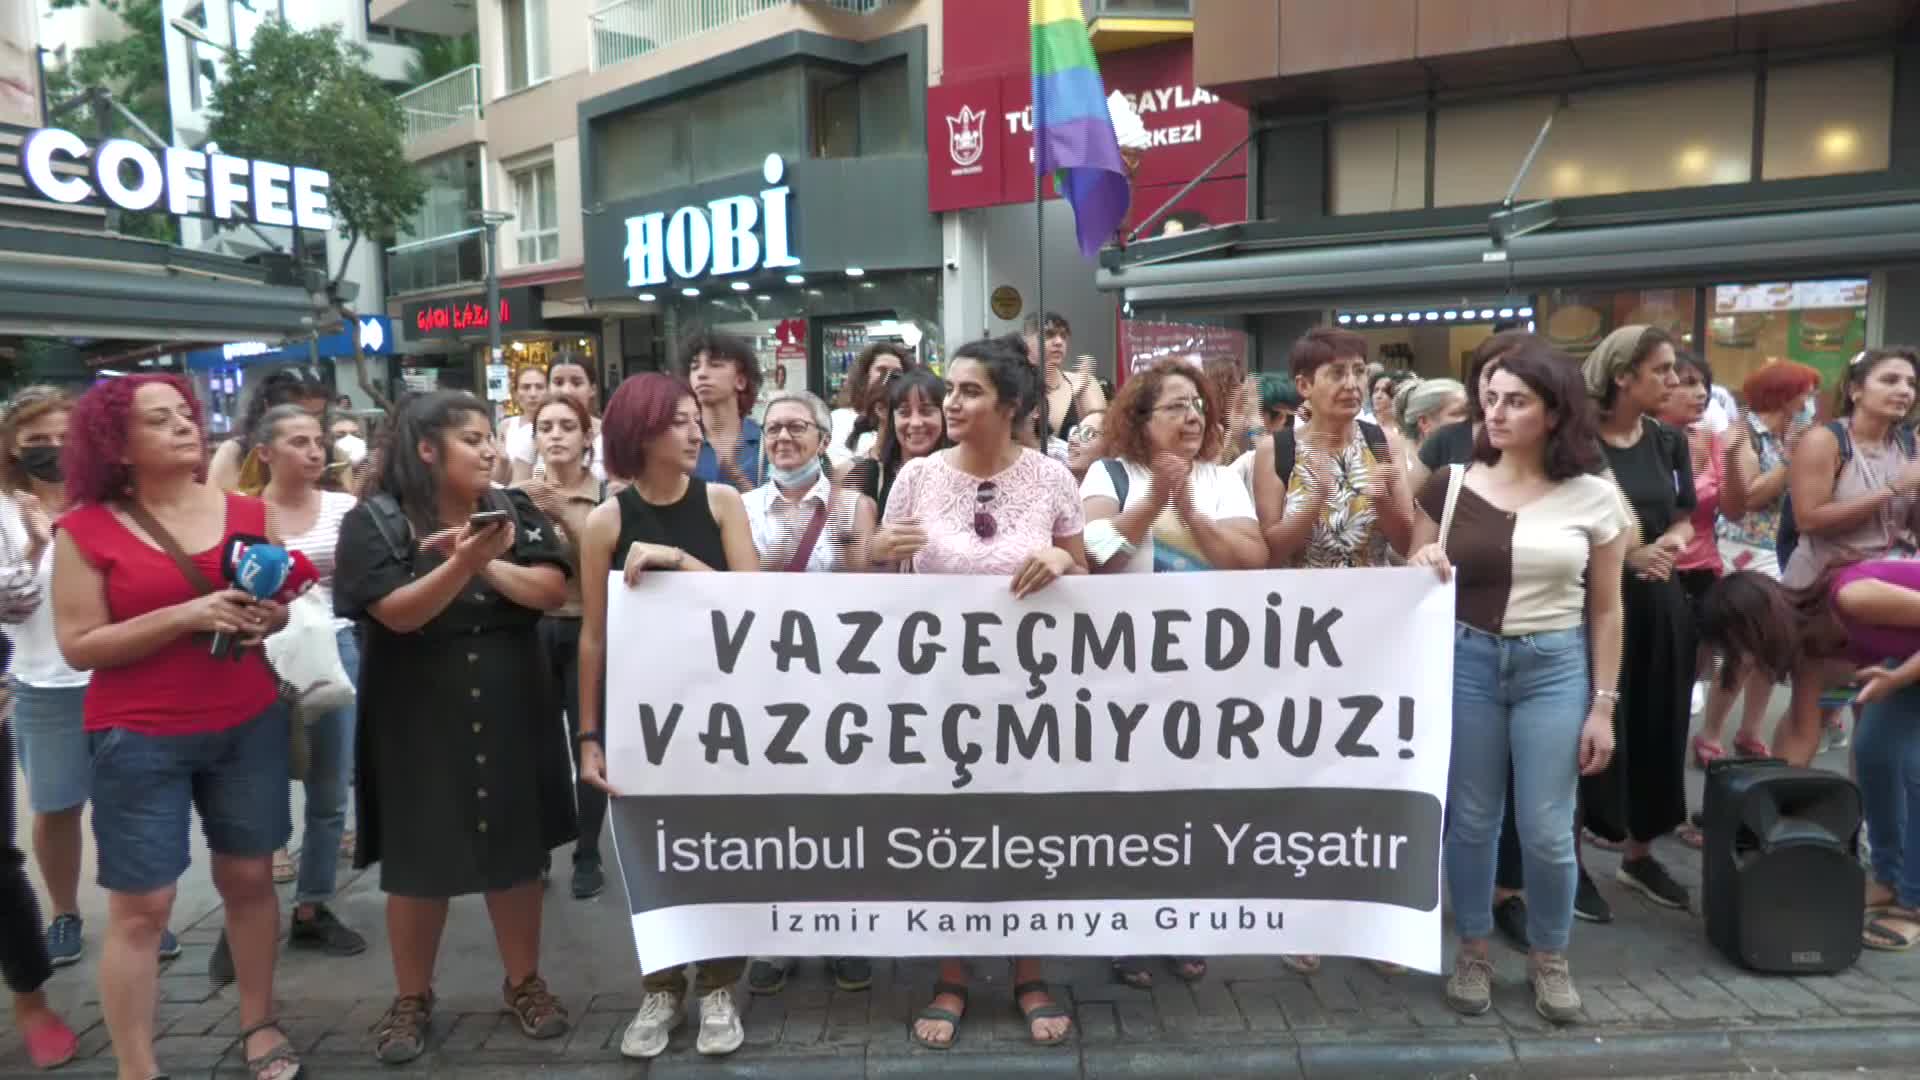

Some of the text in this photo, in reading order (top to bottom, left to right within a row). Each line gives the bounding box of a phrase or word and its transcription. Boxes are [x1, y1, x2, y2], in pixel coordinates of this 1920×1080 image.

[1123, 85, 1220, 115] SAYLA
[26, 127, 333, 231] COFFEE
[623, 152, 801, 288] HOBİ
[711, 591, 1344, 699] VAZGEÇMEDİK
[638, 688, 1416, 788] VAZGEÇMİYORUZ!
[656, 819, 1408, 880] İstanbul Sözleşmesi Yaşatır
[771, 904, 1284, 937] İzmir Kampanya Grubu
